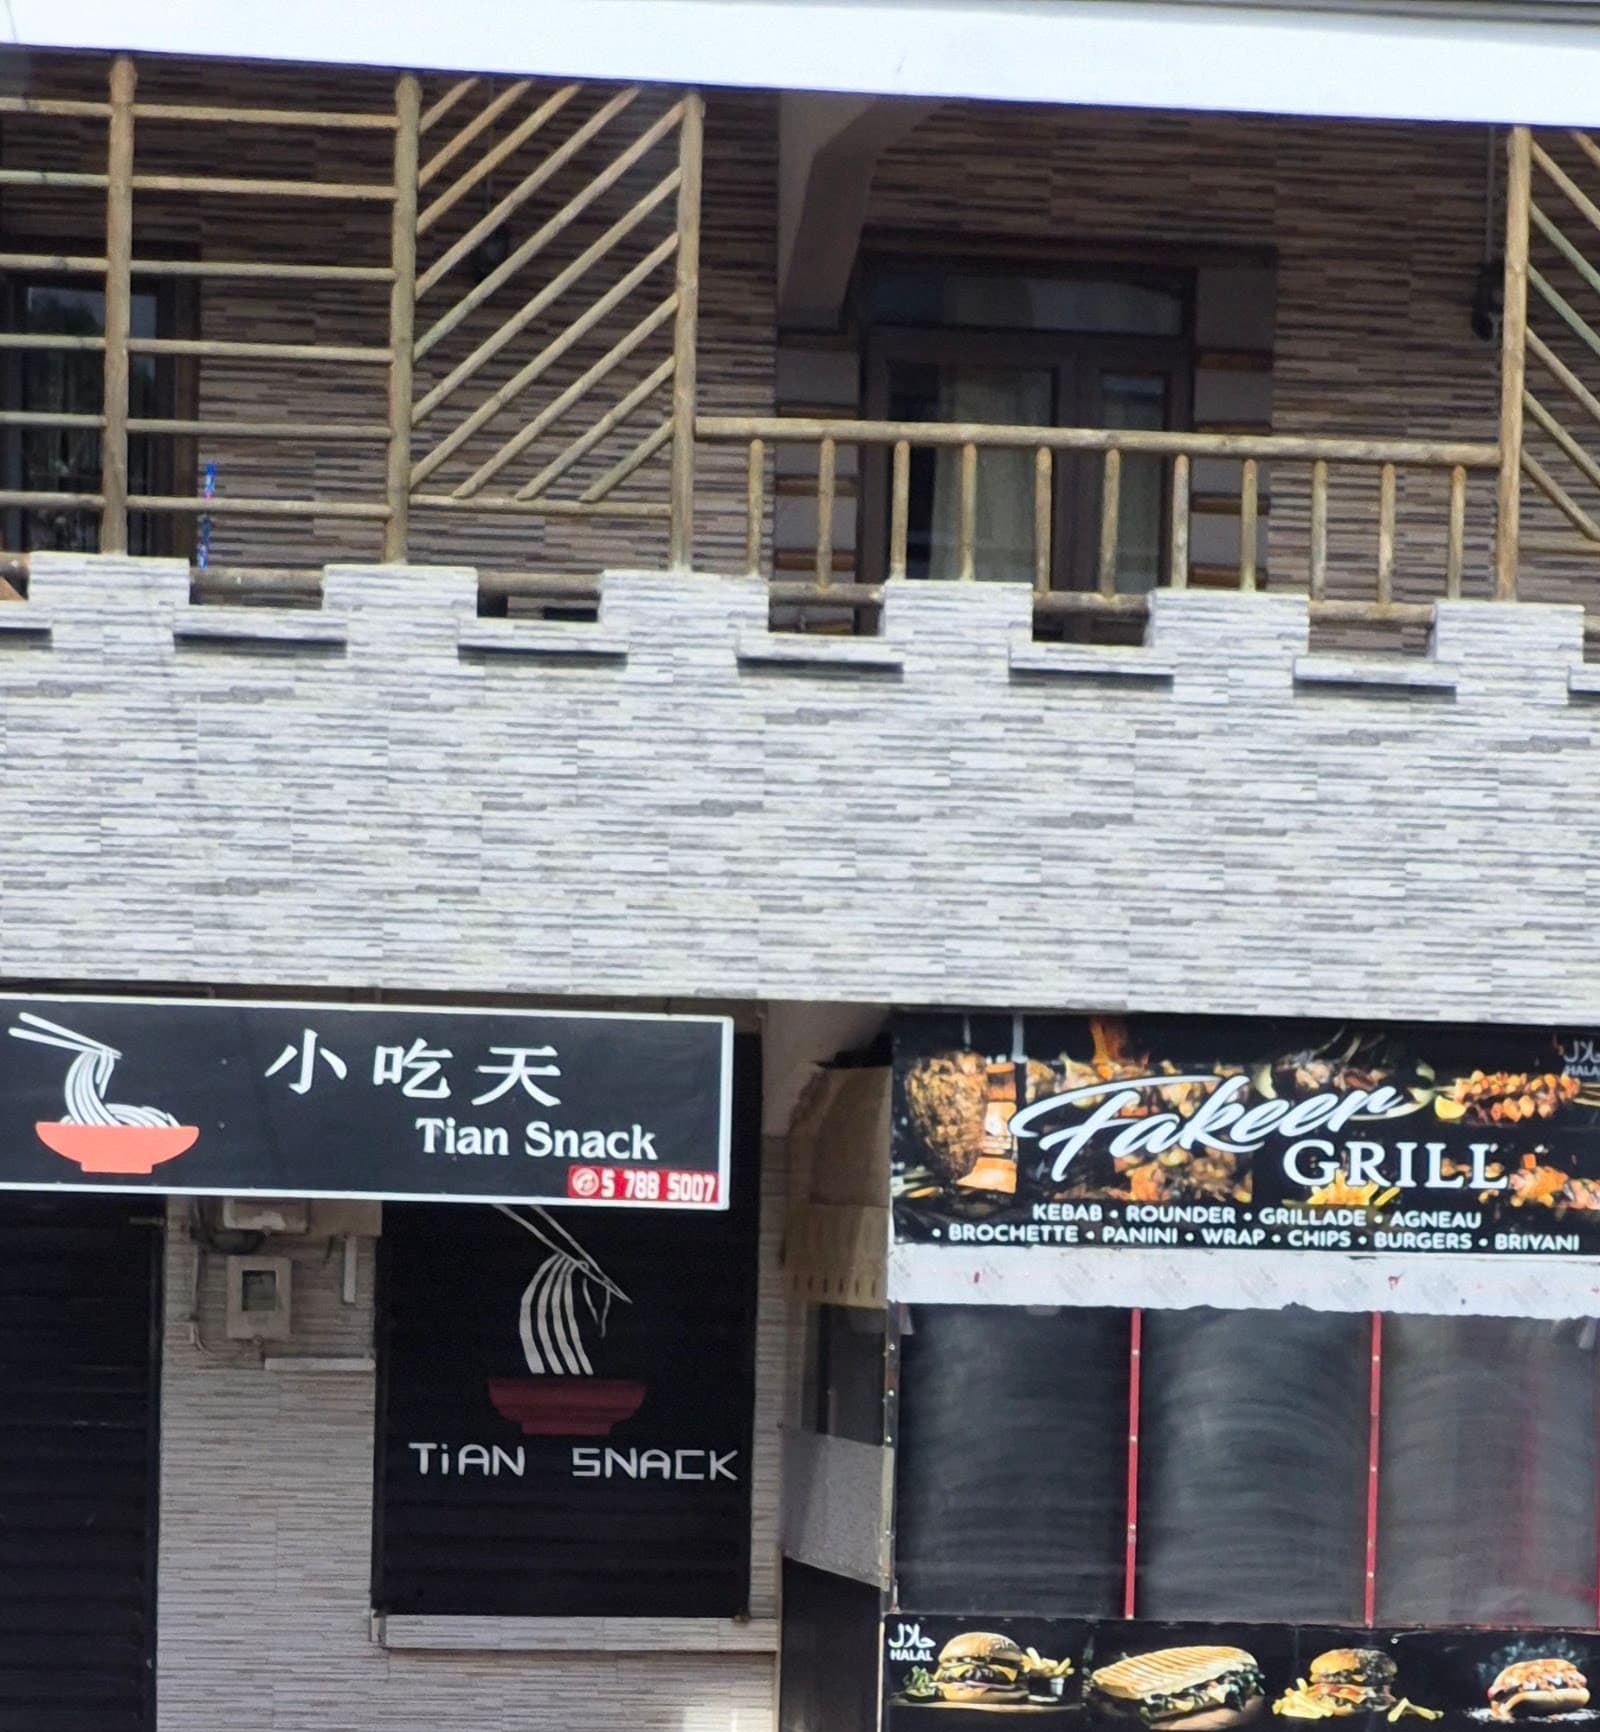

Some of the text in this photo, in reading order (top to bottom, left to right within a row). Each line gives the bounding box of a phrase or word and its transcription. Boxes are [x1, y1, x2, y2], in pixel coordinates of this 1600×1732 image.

[264, 1029, 562, 1108] 小吃天
[1564, 1065, 1600, 1077] HALA
[415, 1117, 659, 1161] Tian Snack
[1008, 1074, 1418, 1183] Fakeer
[1283, 1139, 1507, 1190] GRILL
[601, 1168, 716, 1203] 5 788 5007
[1033, 1203, 1482, 1229] KEBAB ROUNDER GRILLADE AGNEAU
[949, 1224, 1580, 1251] BROCHETTE PANINI WRAP CHIPS BURGERS BRIYANI
[572, 1446, 739, 1481] SNACK
[887, 1622, 937, 1649] حلال
[889, 1648, 934, 1662] HALAL
